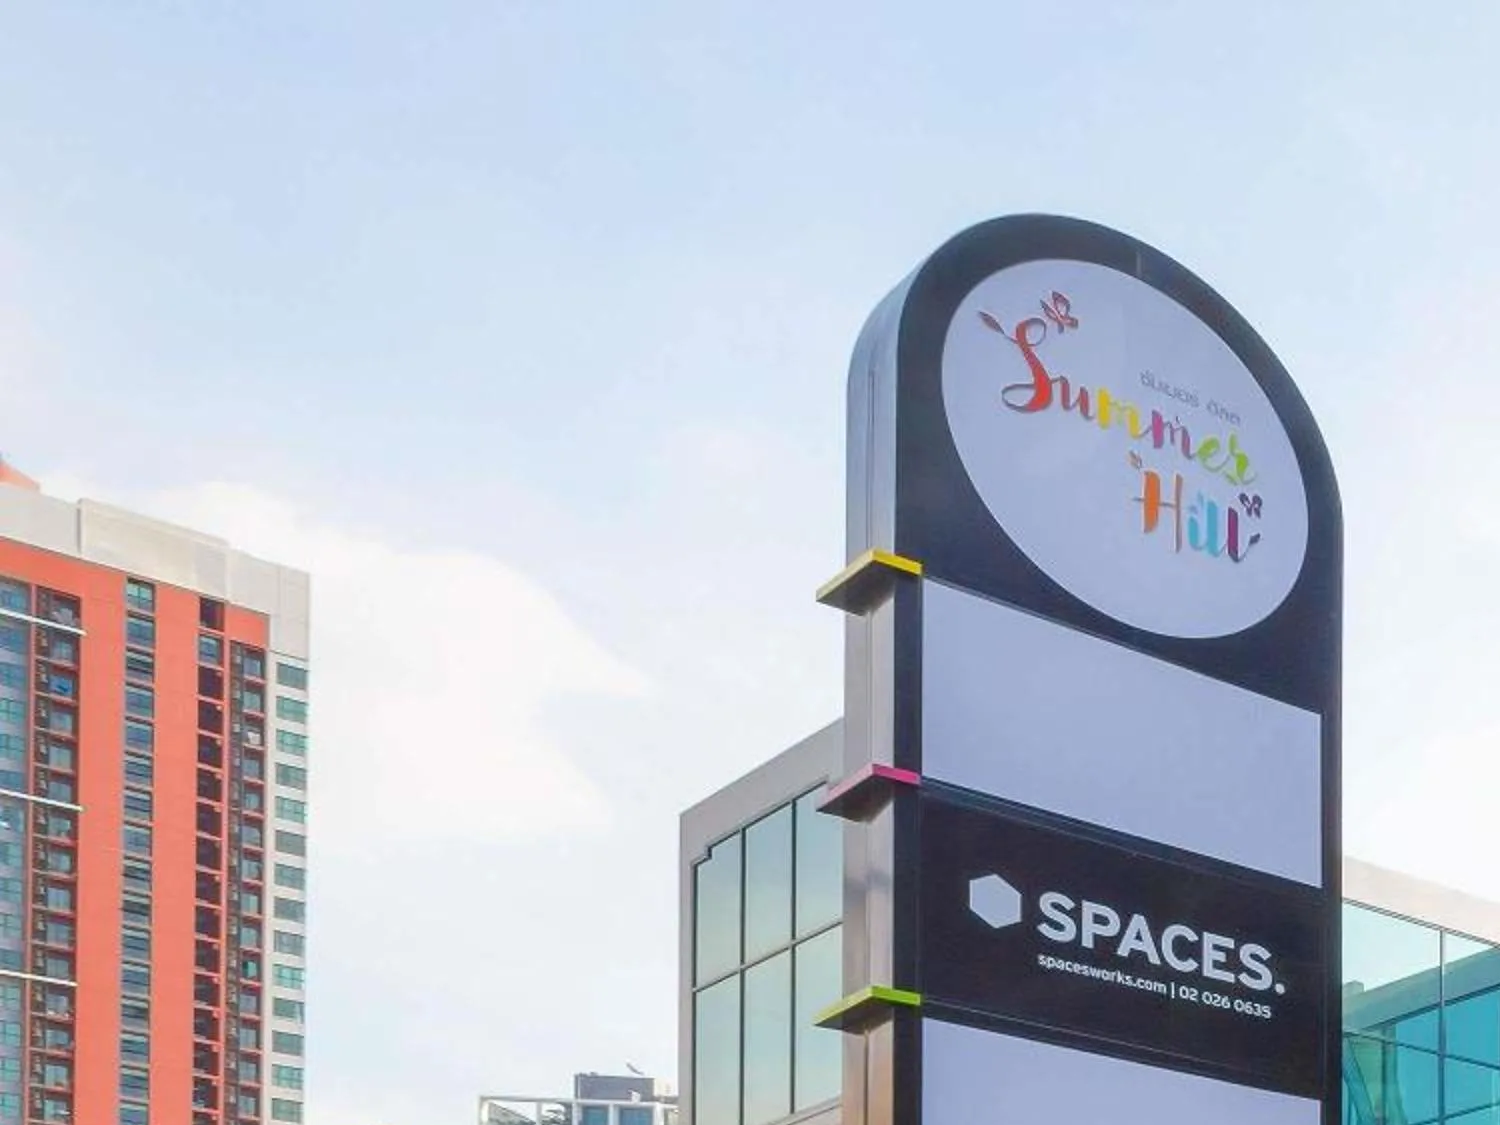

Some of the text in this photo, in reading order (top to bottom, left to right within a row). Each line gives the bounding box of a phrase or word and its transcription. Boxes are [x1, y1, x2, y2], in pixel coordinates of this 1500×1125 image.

[981, 312, 1257, 487] Summer
[1133, 470, 1260, 564] Hill
[1036, 890, 1287, 996] SPACES.
[1037, 954, 1168, 995] spacesworks.com
[1178, 984, 1198, 1001] 02
[1201, 991, 1231, 1011] 026
[1233, 999, 1272, 1020] 0635
